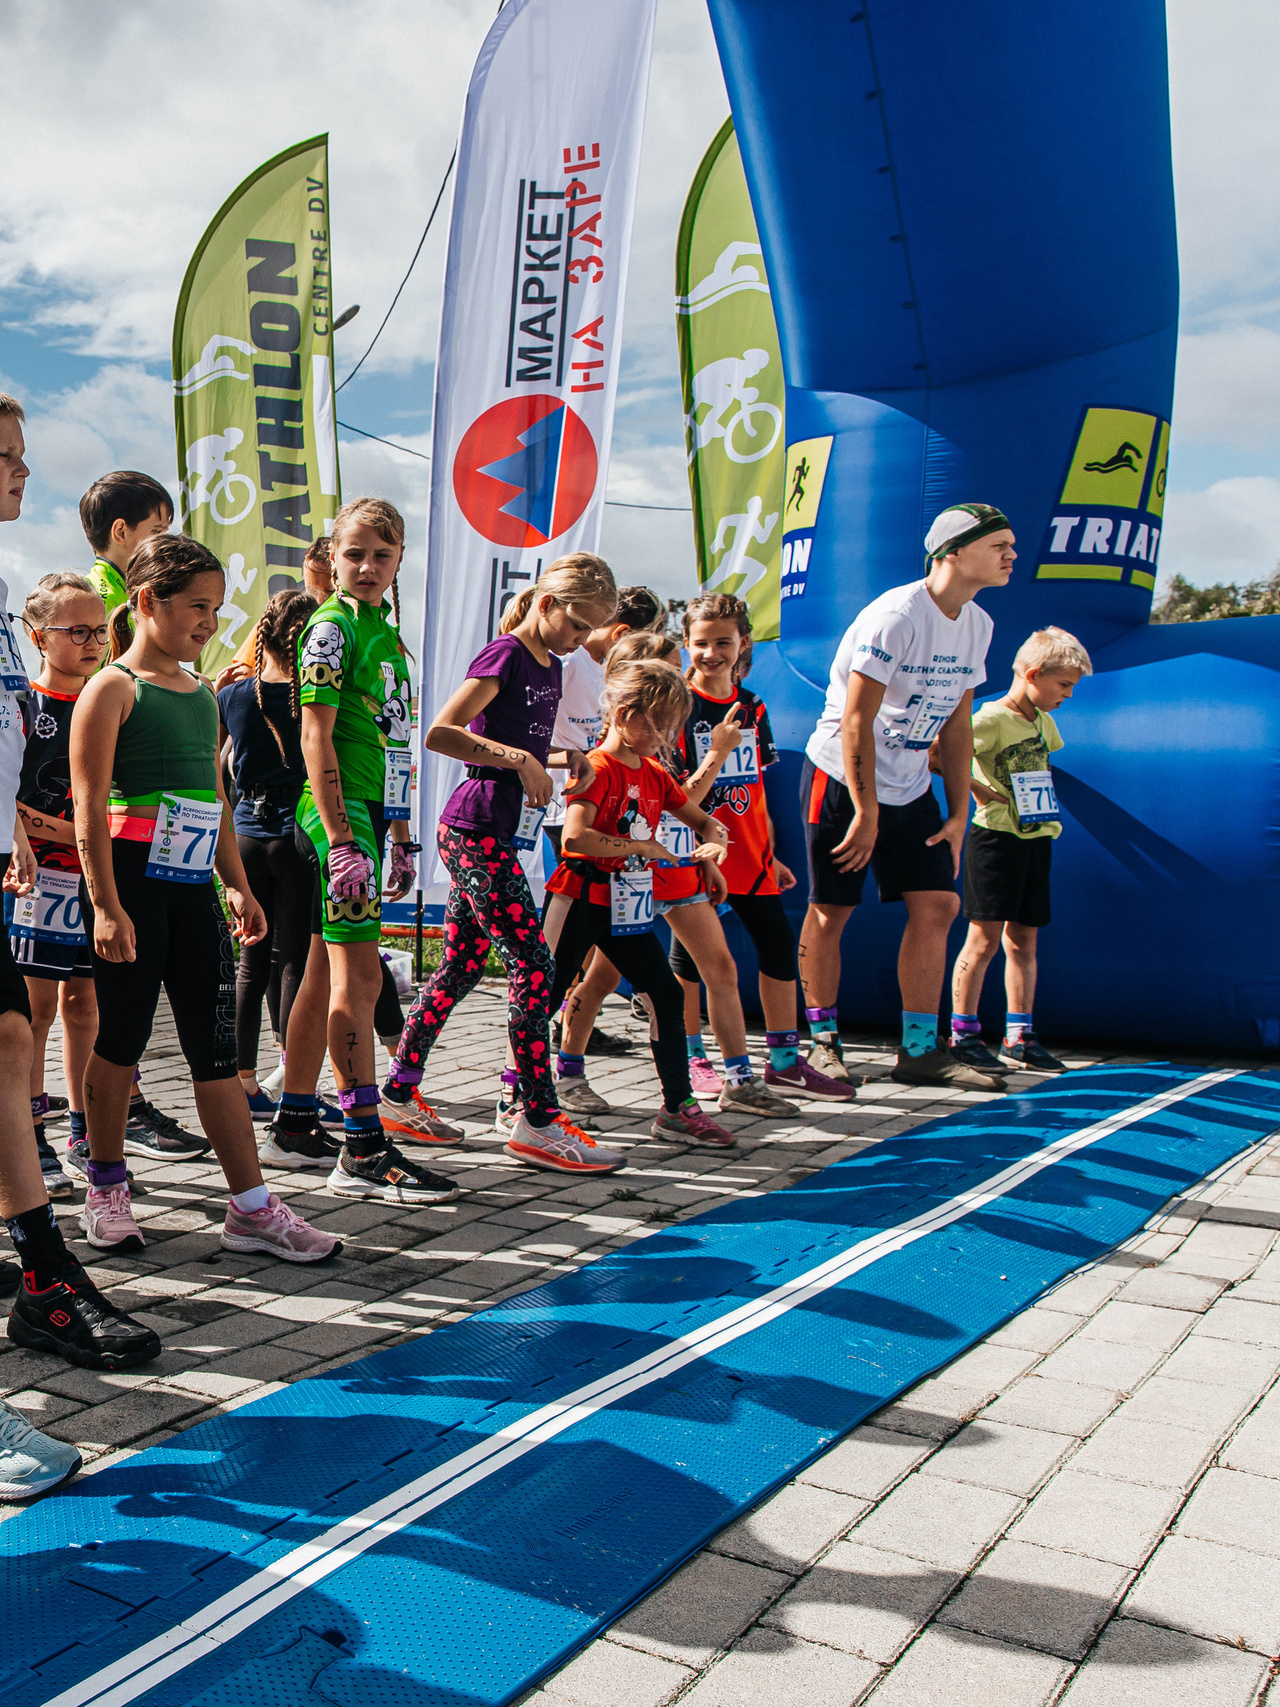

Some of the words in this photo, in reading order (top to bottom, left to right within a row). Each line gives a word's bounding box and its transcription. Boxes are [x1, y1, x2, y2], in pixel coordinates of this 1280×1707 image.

[306, 176, 325, 213] DV
[563, 142, 604, 284] ЗАРЕ
[312, 228, 328, 337] CENTRE
[516, 180, 566, 382] МАРКЕТ
[571, 315, 604, 393] НА
[792, 583, 805, 596] DV
[301, 663, 343, 689] DOG
[720, 746, 755, 774] 12
[324, 769, 350, 833] 713
[42, 875, 77, 885] ВСЕРОССИЙСКИЕ
[49, 881, 77, 890] ТРИАТЛОНУ
[41, 891, 82, 930] 70
[326, 895, 381, 922] DOG
